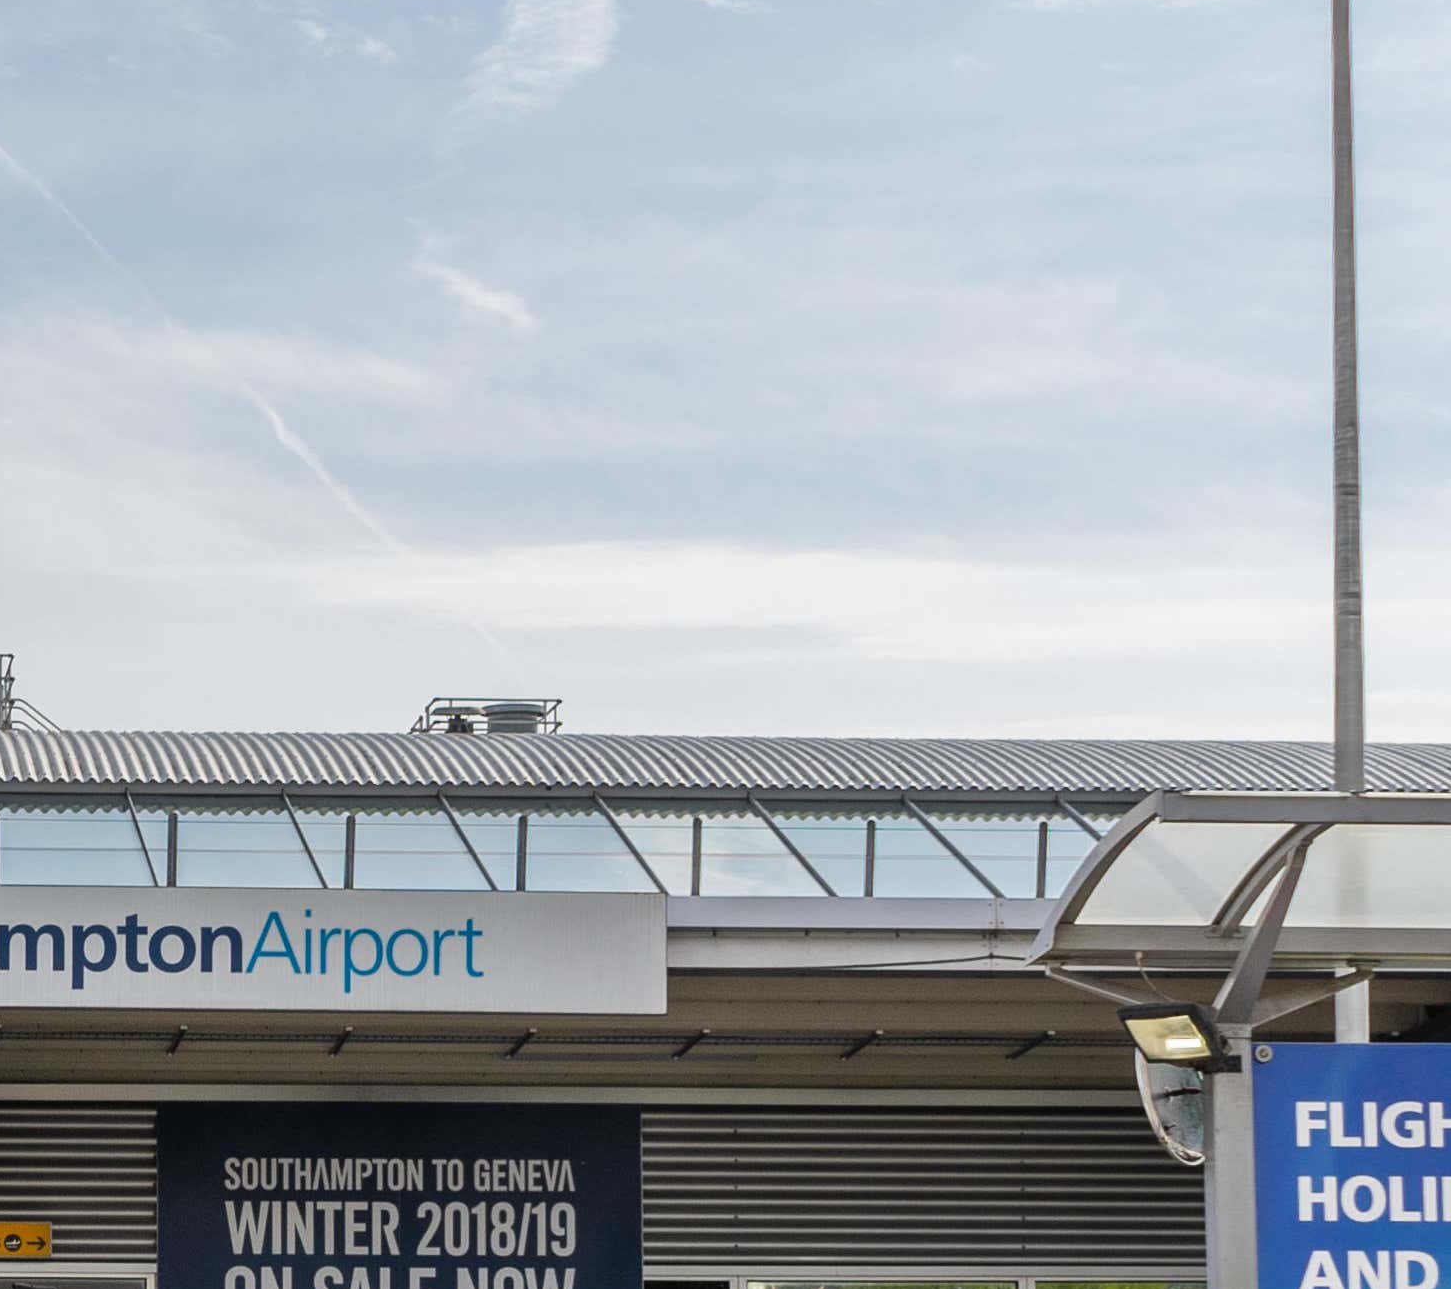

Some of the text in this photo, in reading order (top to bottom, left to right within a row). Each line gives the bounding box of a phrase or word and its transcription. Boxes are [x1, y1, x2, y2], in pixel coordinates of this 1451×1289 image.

[224, 1158, 576, 1192] SOUTHAMPTON TO GENEVA
[225, 1202, 577, 1257] WINTER 2018/19
